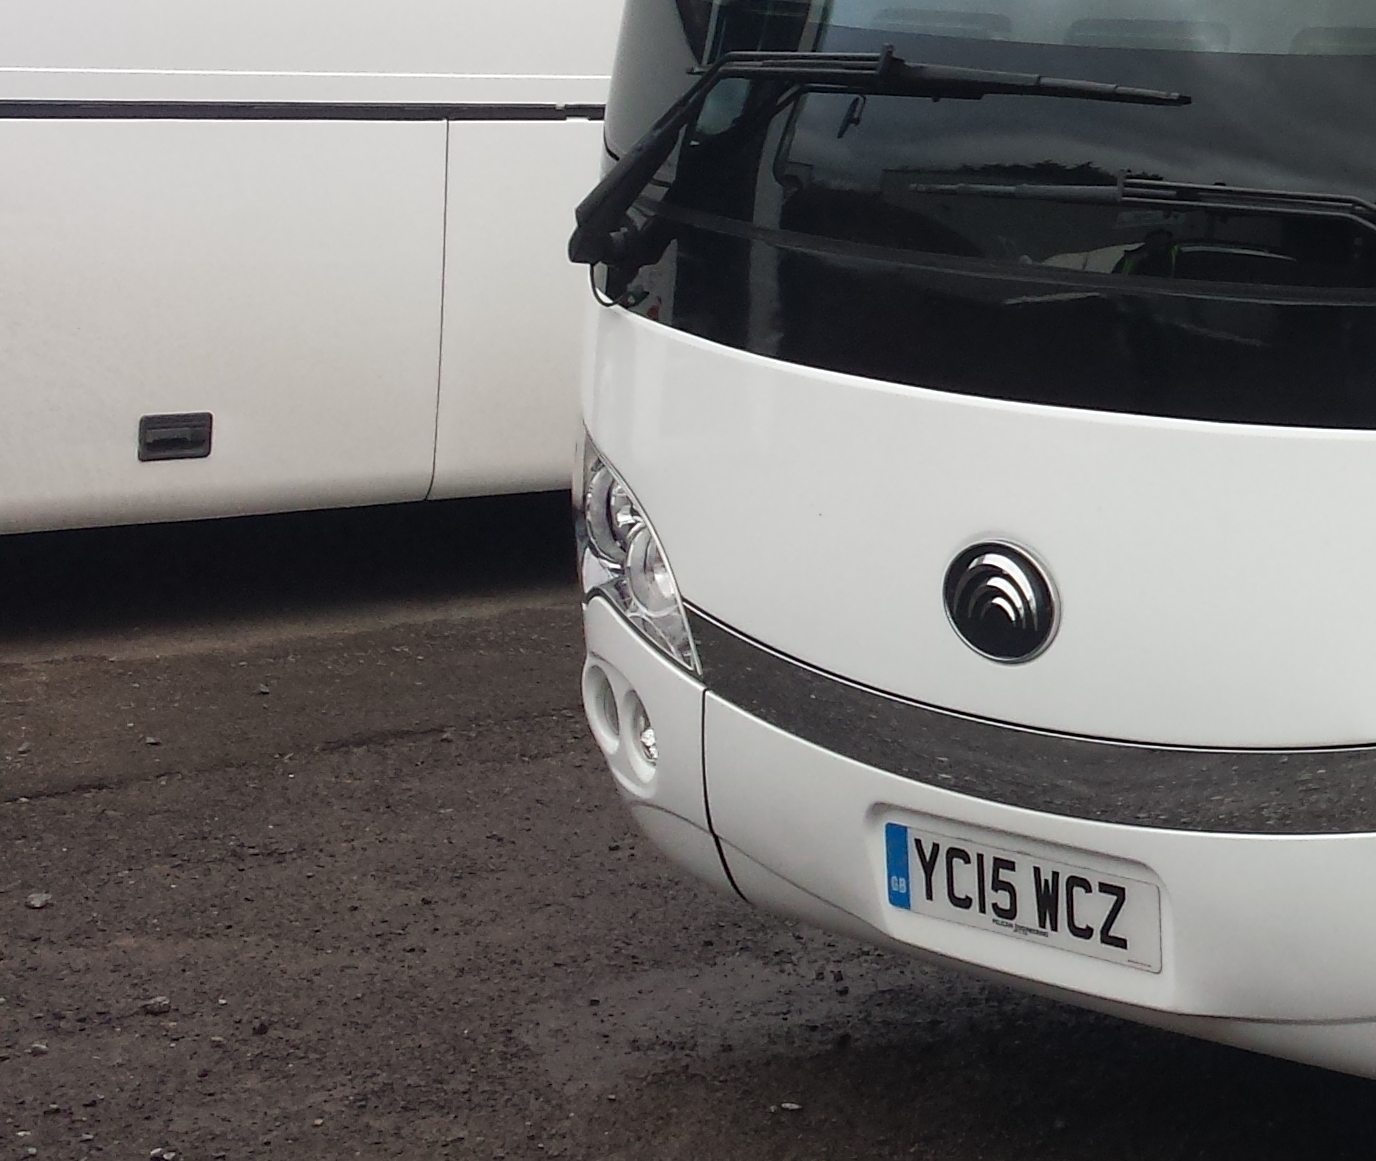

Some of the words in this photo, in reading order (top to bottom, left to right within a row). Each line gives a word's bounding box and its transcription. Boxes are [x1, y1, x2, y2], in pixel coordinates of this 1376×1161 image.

[890, 875, 907, 894] GB
[914, 837, 1018, 921] YC15
[1033, 865, 1128, 950] WCZ
